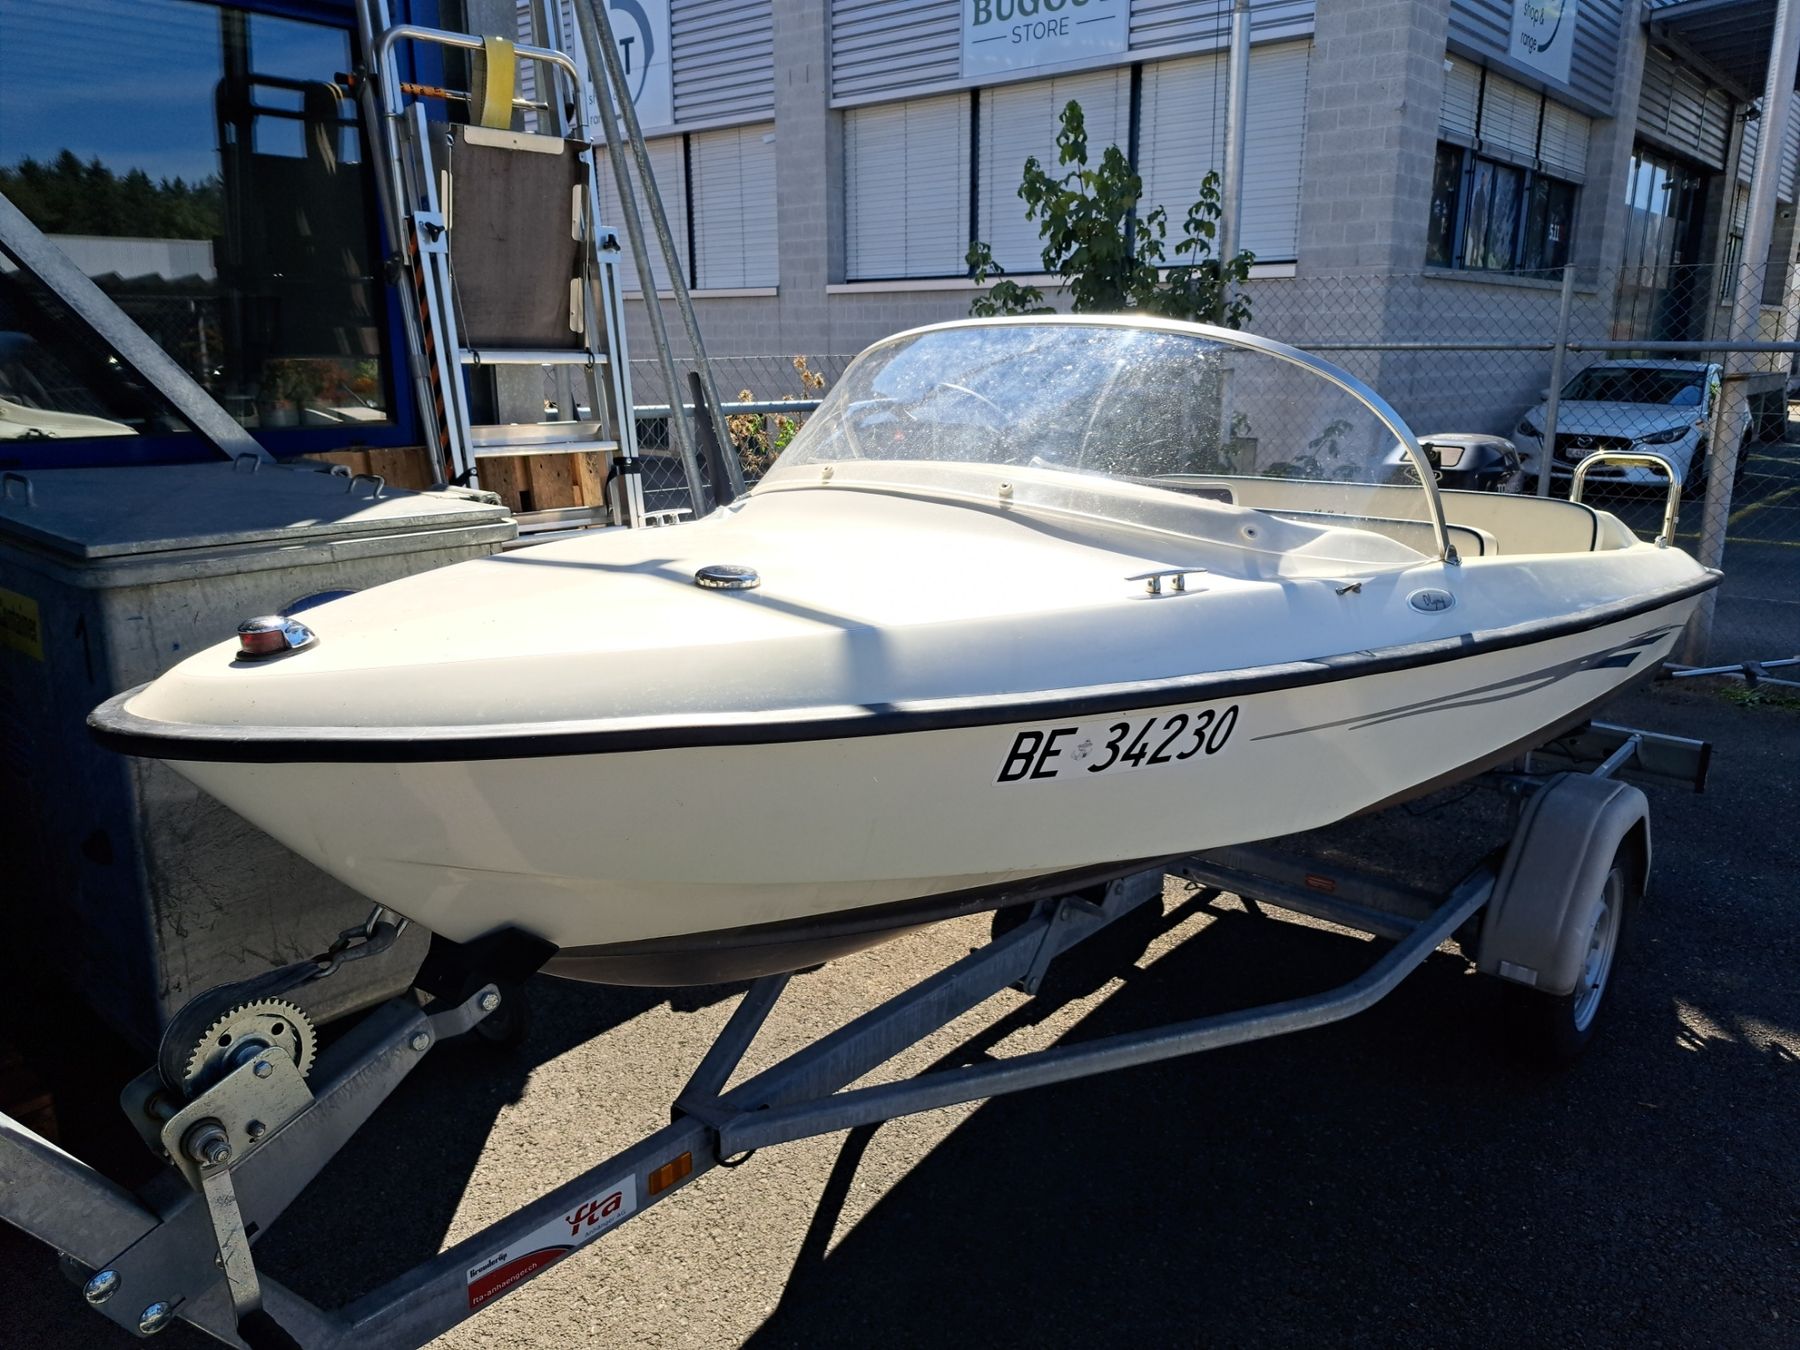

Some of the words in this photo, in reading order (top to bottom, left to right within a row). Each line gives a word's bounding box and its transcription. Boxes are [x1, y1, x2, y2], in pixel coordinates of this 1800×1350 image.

[973, 0, 1111, 26] BUG
[1011, 16, 1070, 44] STORE
[1520, 32, 1538, 54] range
[997, 727, 1079, 783] BE
[1087, 704, 1239, 773] 34230
[565, 1191, 622, 1237] fta
